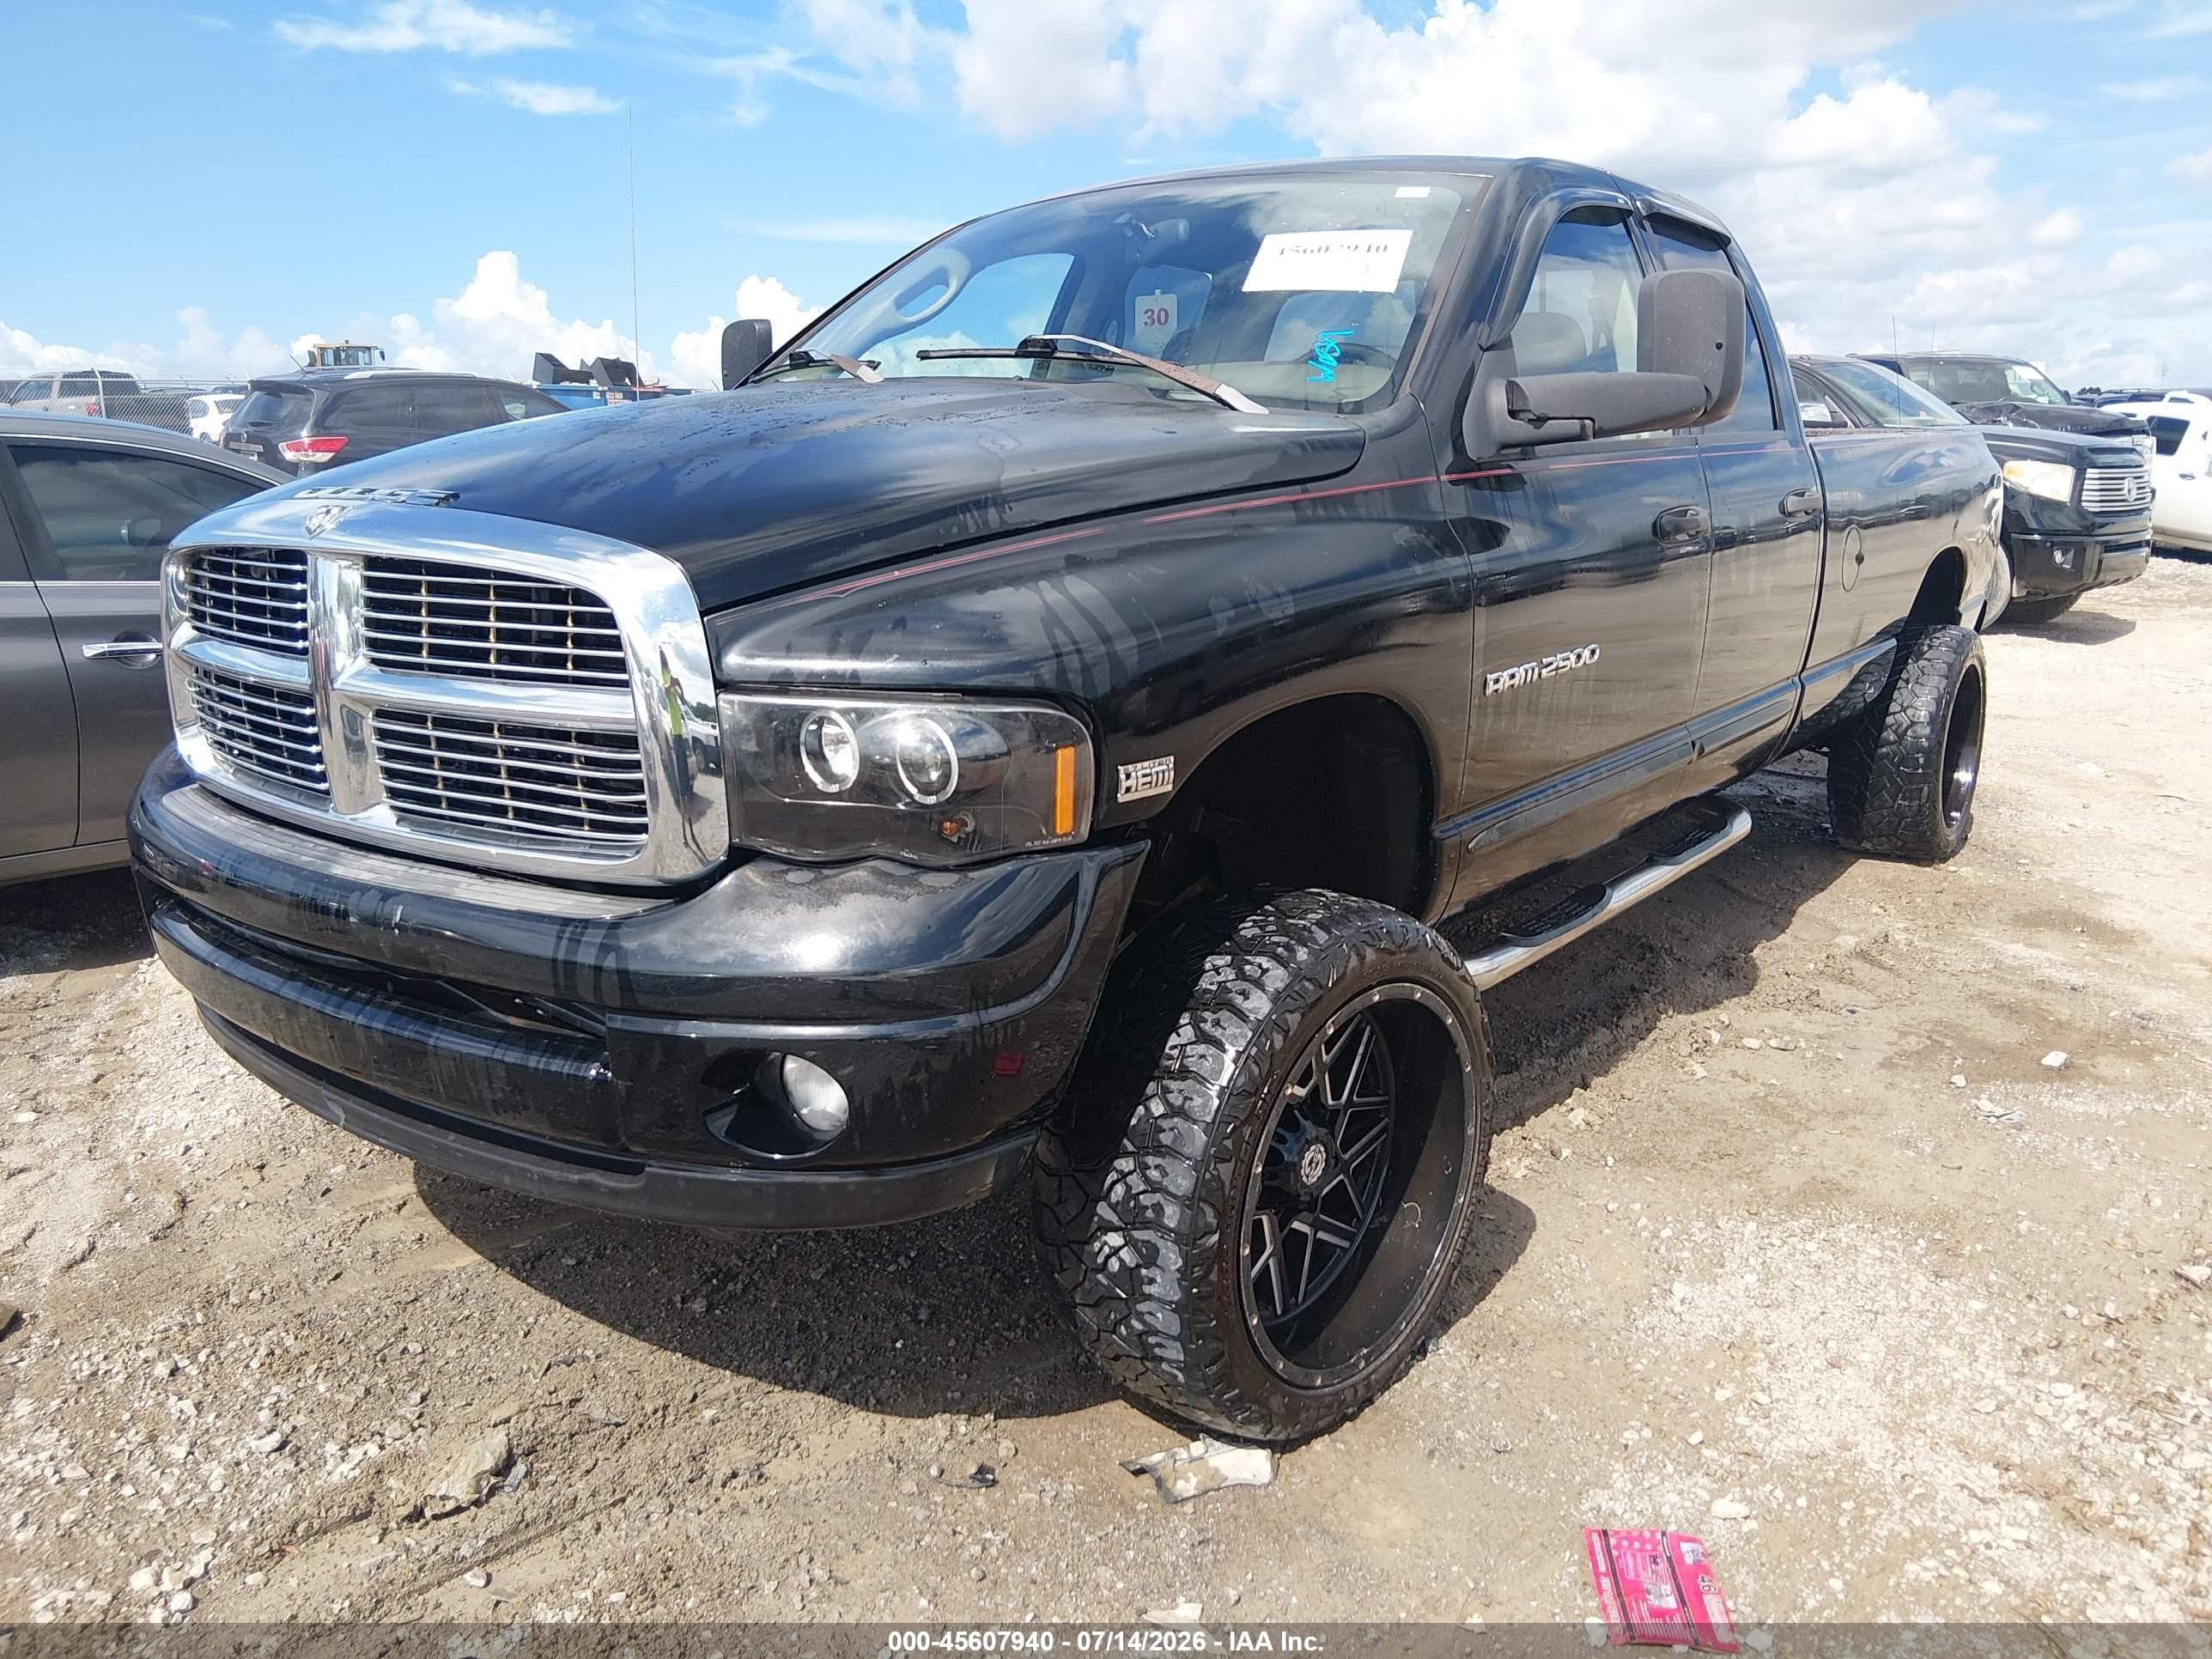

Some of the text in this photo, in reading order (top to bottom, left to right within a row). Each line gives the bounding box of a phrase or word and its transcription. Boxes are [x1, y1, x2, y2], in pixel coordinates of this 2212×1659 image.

[1143, 307, 1170, 326] 30
[1484, 644, 1600, 696] RAM 2500
[1120, 764, 1174, 793] HEMI
[1698, 1574, 1717, 1595] 46
